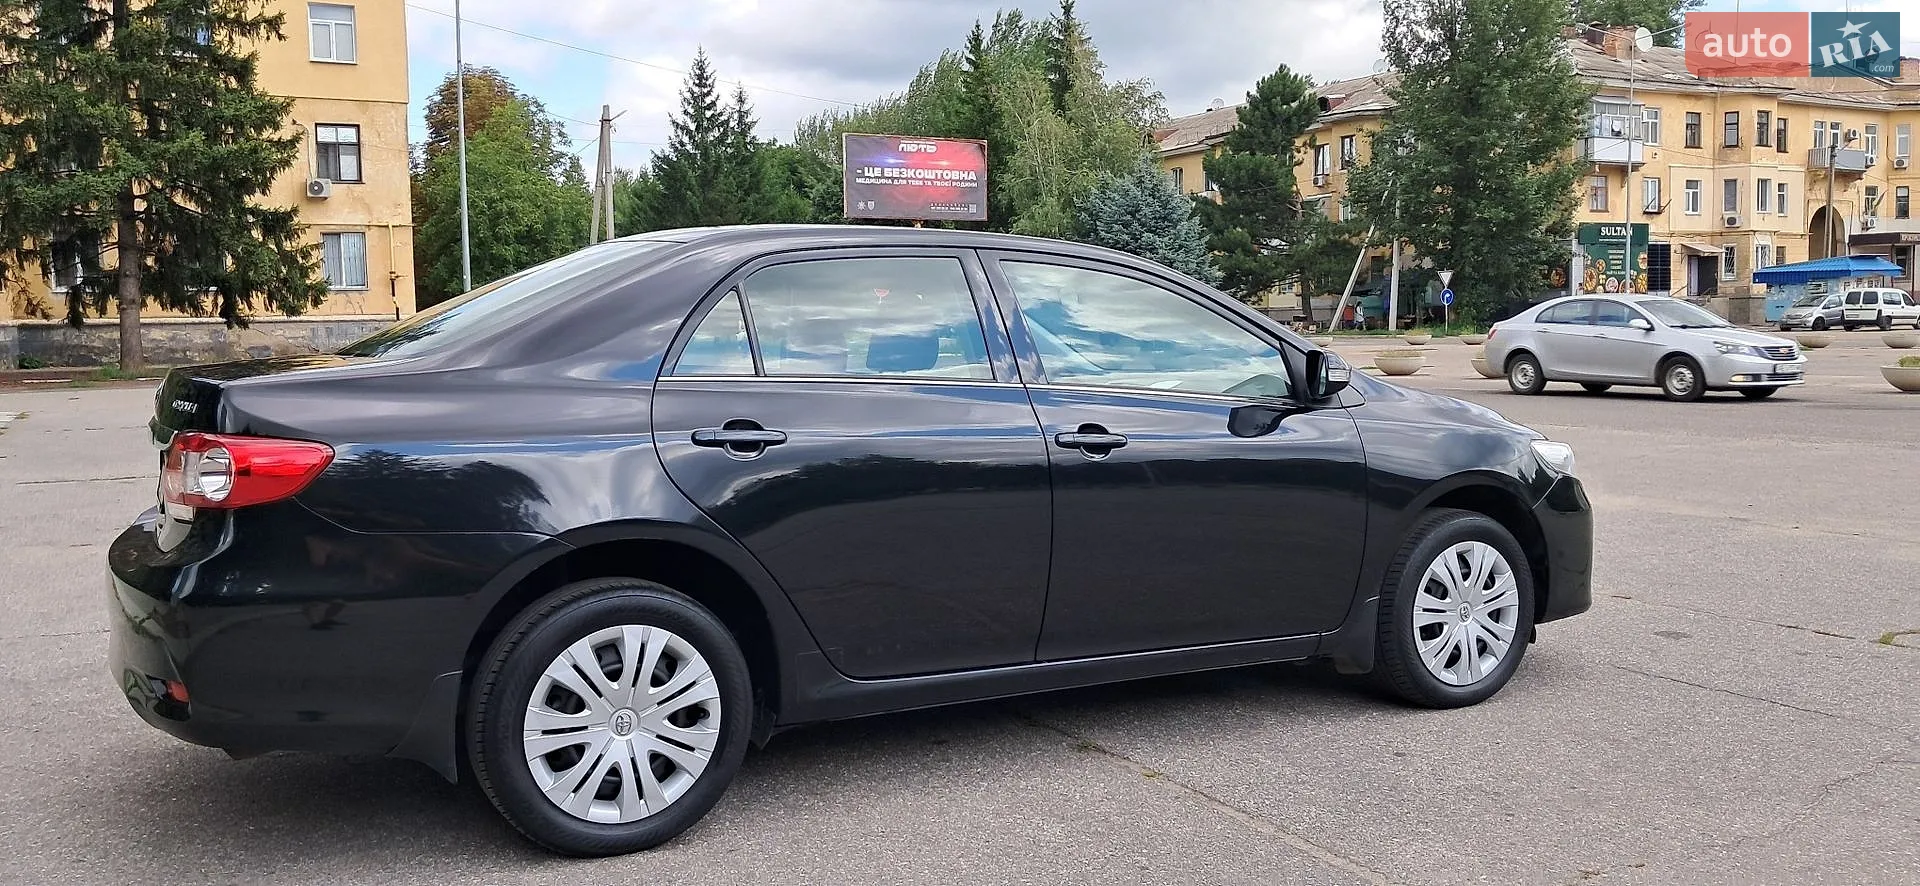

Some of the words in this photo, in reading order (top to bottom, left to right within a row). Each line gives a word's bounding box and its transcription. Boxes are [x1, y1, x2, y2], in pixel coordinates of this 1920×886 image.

[898, 143, 937, 153] ЛЮТЬ
[864, 166, 882, 177] ЦЕ
[884, 167, 977, 180] БЕЗКОШТОВНА
[855, 177, 892, 185] МЕДИЦИНА
